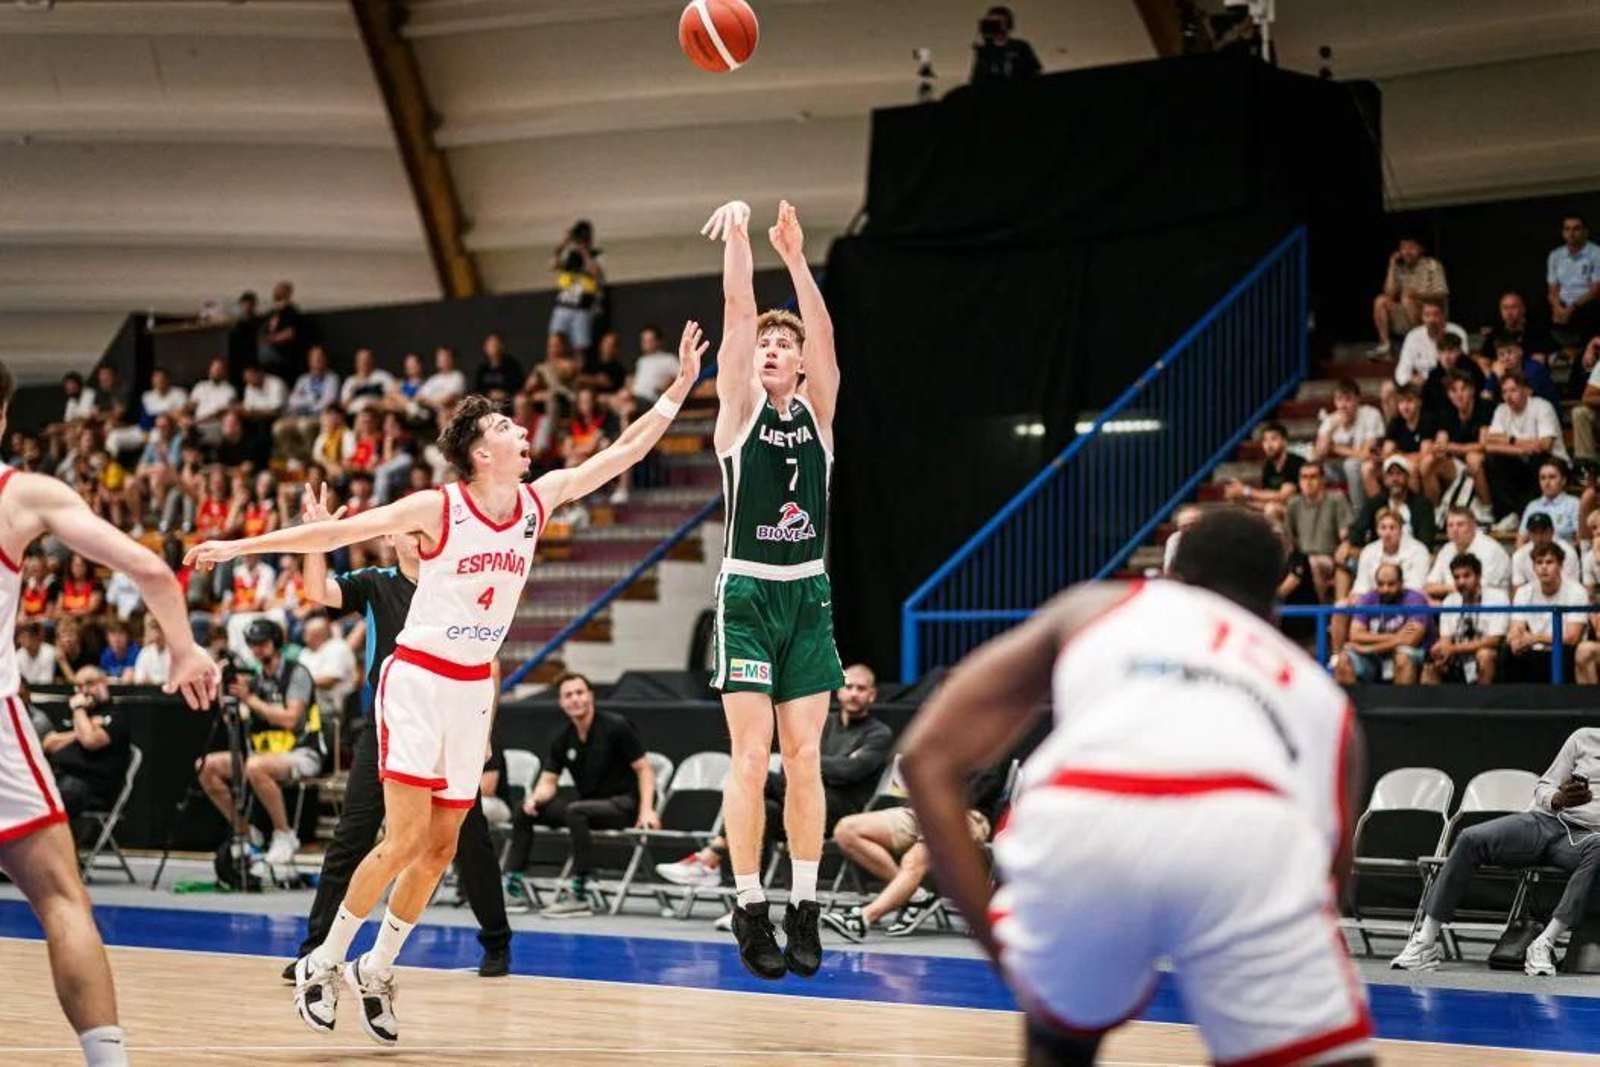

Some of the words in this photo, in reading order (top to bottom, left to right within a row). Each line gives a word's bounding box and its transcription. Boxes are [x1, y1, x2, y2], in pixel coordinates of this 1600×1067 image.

[759, 424, 813, 448] LIETVA
[786, 458, 799, 491] 7
[457, 548, 525, 577] ESPAÑA
[477, 586, 494, 610] 4
